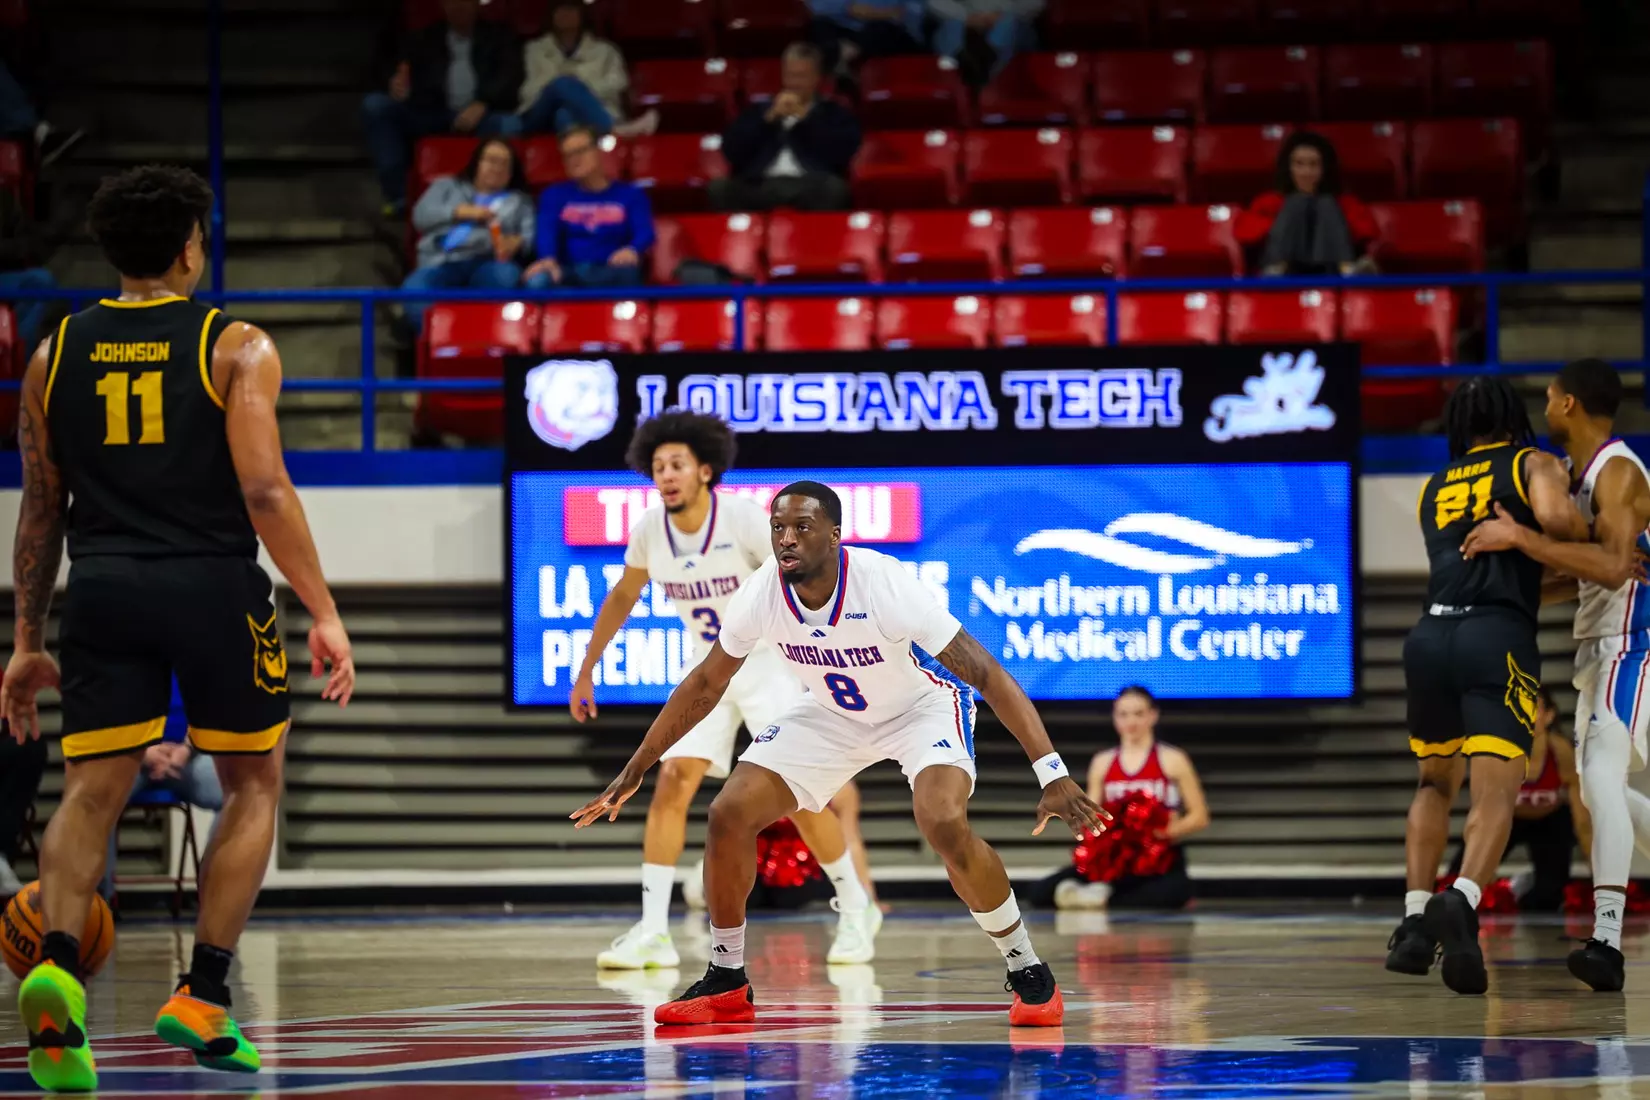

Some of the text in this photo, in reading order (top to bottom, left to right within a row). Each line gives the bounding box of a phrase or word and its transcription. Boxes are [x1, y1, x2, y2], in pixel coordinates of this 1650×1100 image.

[89, 341, 170, 362] JOHNSON
[95, 371, 165, 445] 11
[636, 373, 998, 432] LOUISIANA
[1001, 368, 1182, 429] TECH
[1434, 474, 1494, 530] 21
[538, 565, 594, 618] LA
[969, 571, 1150, 617] Northern
[1157, 572, 1342, 615] Louisiana
[691, 607, 721, 642] 3
[1002, 615, 1306, 662] Medical Center
[777, 642, 885, 668] LOUISIANA TECH
[823, 672, 869, 712] 8
